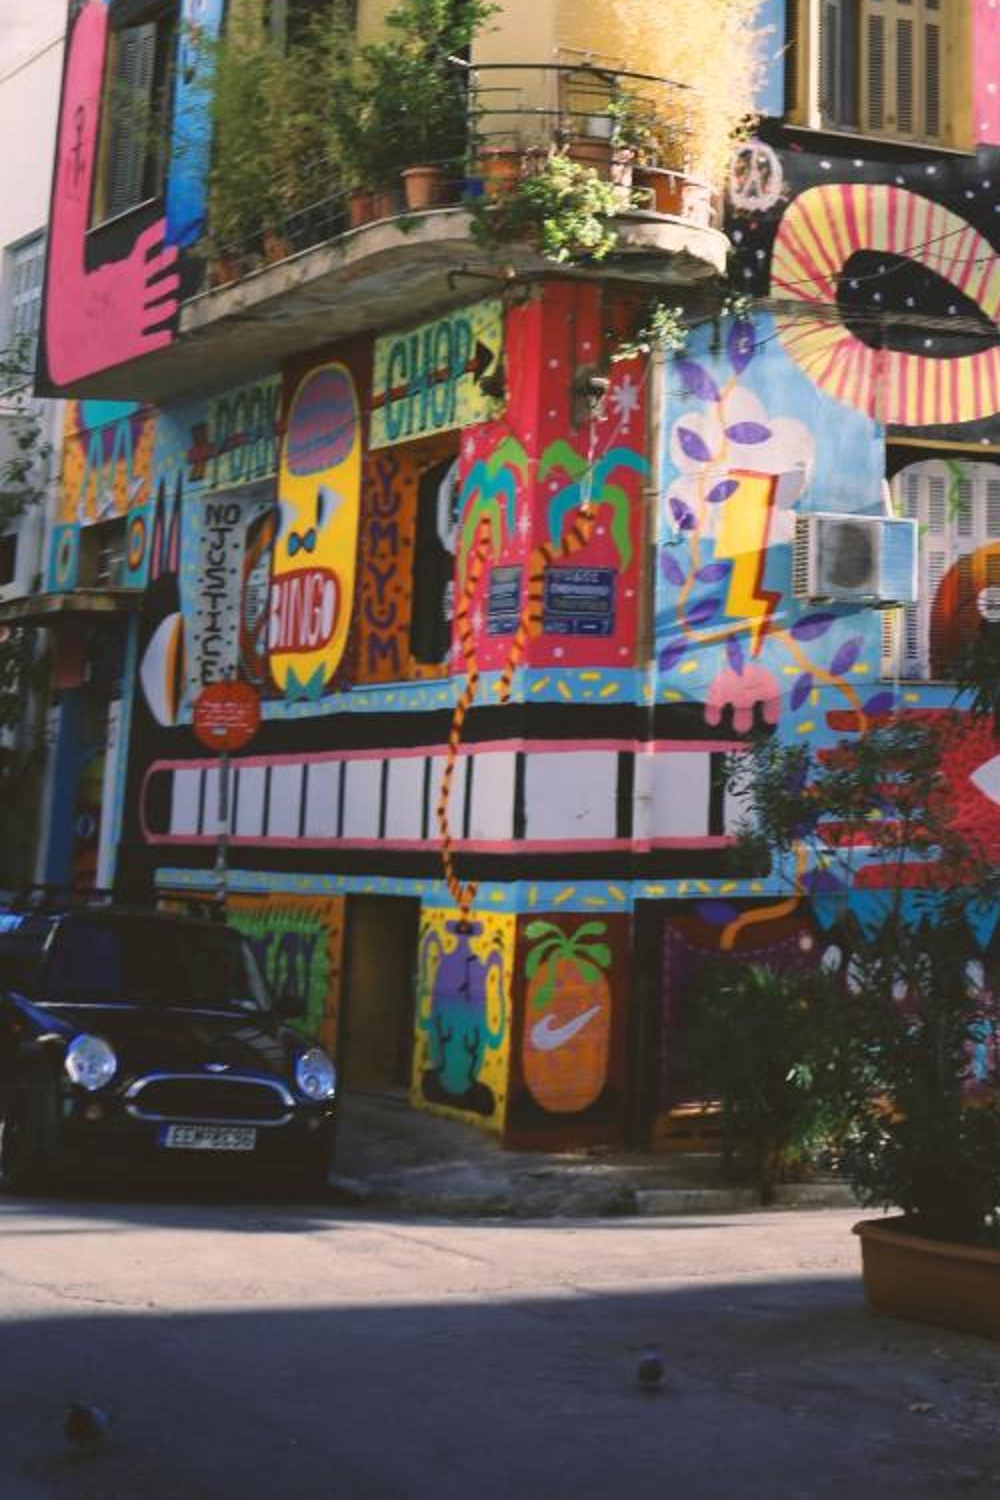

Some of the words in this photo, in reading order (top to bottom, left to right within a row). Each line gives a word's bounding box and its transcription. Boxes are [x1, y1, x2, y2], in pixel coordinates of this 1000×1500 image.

[385, 318, 472, 441] CHOP
[205, 503, 240, 526] NO
[201, 526, 234, 686] JUSTICE
[269, 572, 337, 650] BINGO
